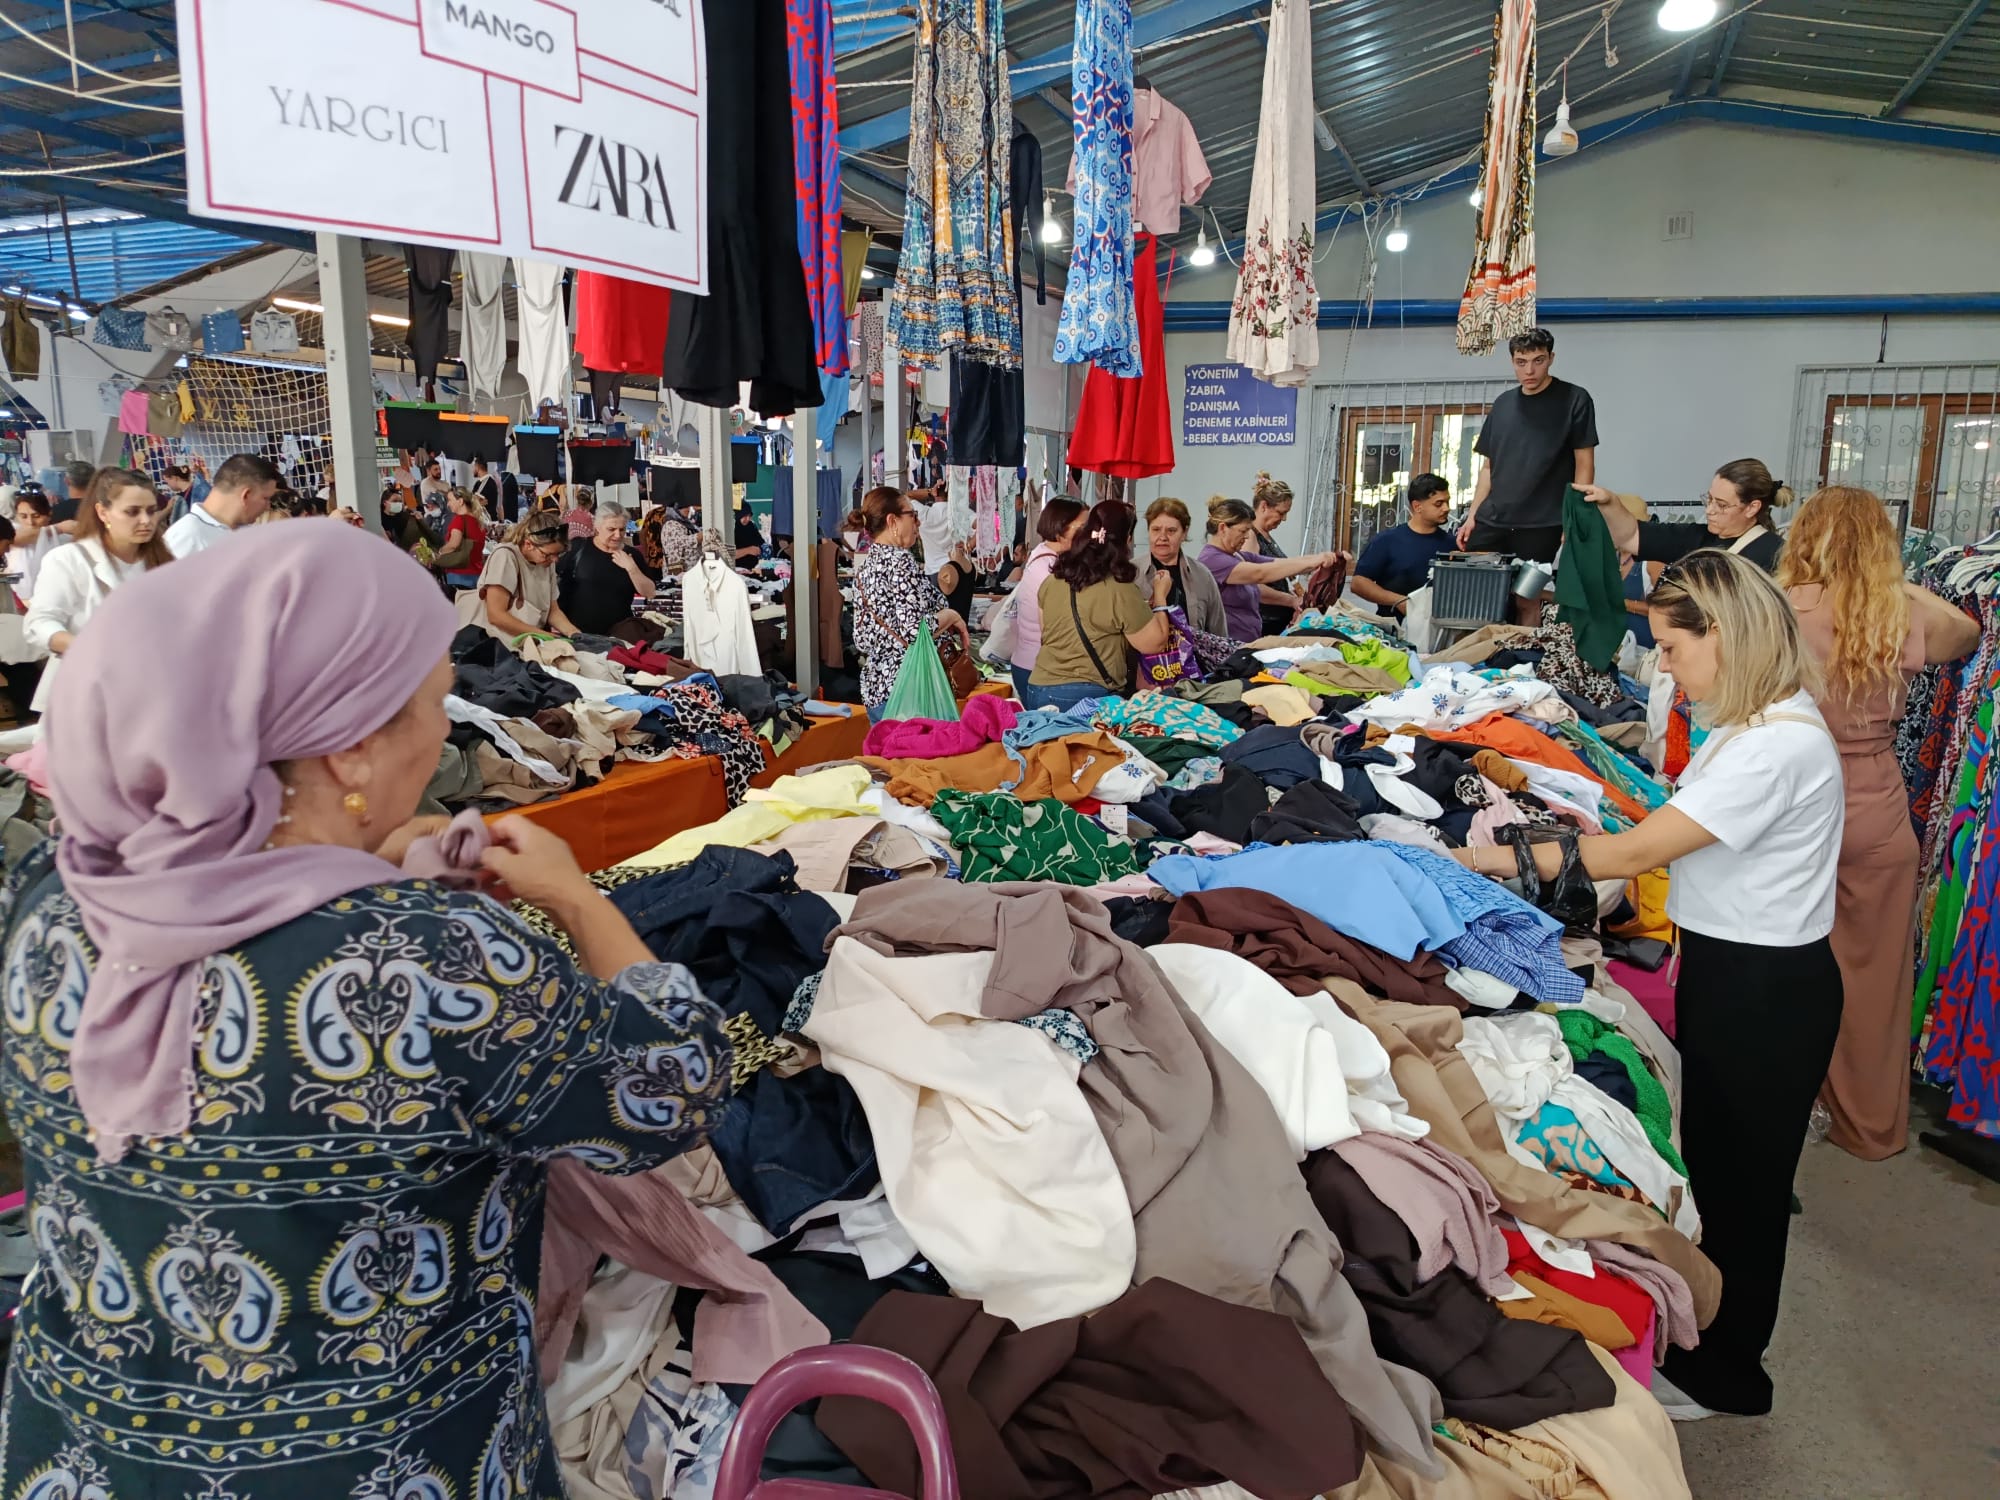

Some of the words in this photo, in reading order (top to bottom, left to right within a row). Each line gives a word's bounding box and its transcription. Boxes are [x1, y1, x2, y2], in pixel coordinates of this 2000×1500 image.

[445, 0, 555, 54] MANGO
[268, 85, 449, 153] YARGICI
[554, 124, 682, 234] ZARA
[1191, 367, 1239, 379] YÖNETİM
[1190, 385, 1225, 396] ZABITA
[1190, 401, 1240, 414] DANIŞMA
[1189, 417, 1232, 428] DENEME
[1234, 414, 1288, 427] KABİNLERİ
[1188, 433, 1219, 443] BEBEK
[1222, 433, 1256, 443] BAKIM
[1258, 432, 1294, 443] ODASI
